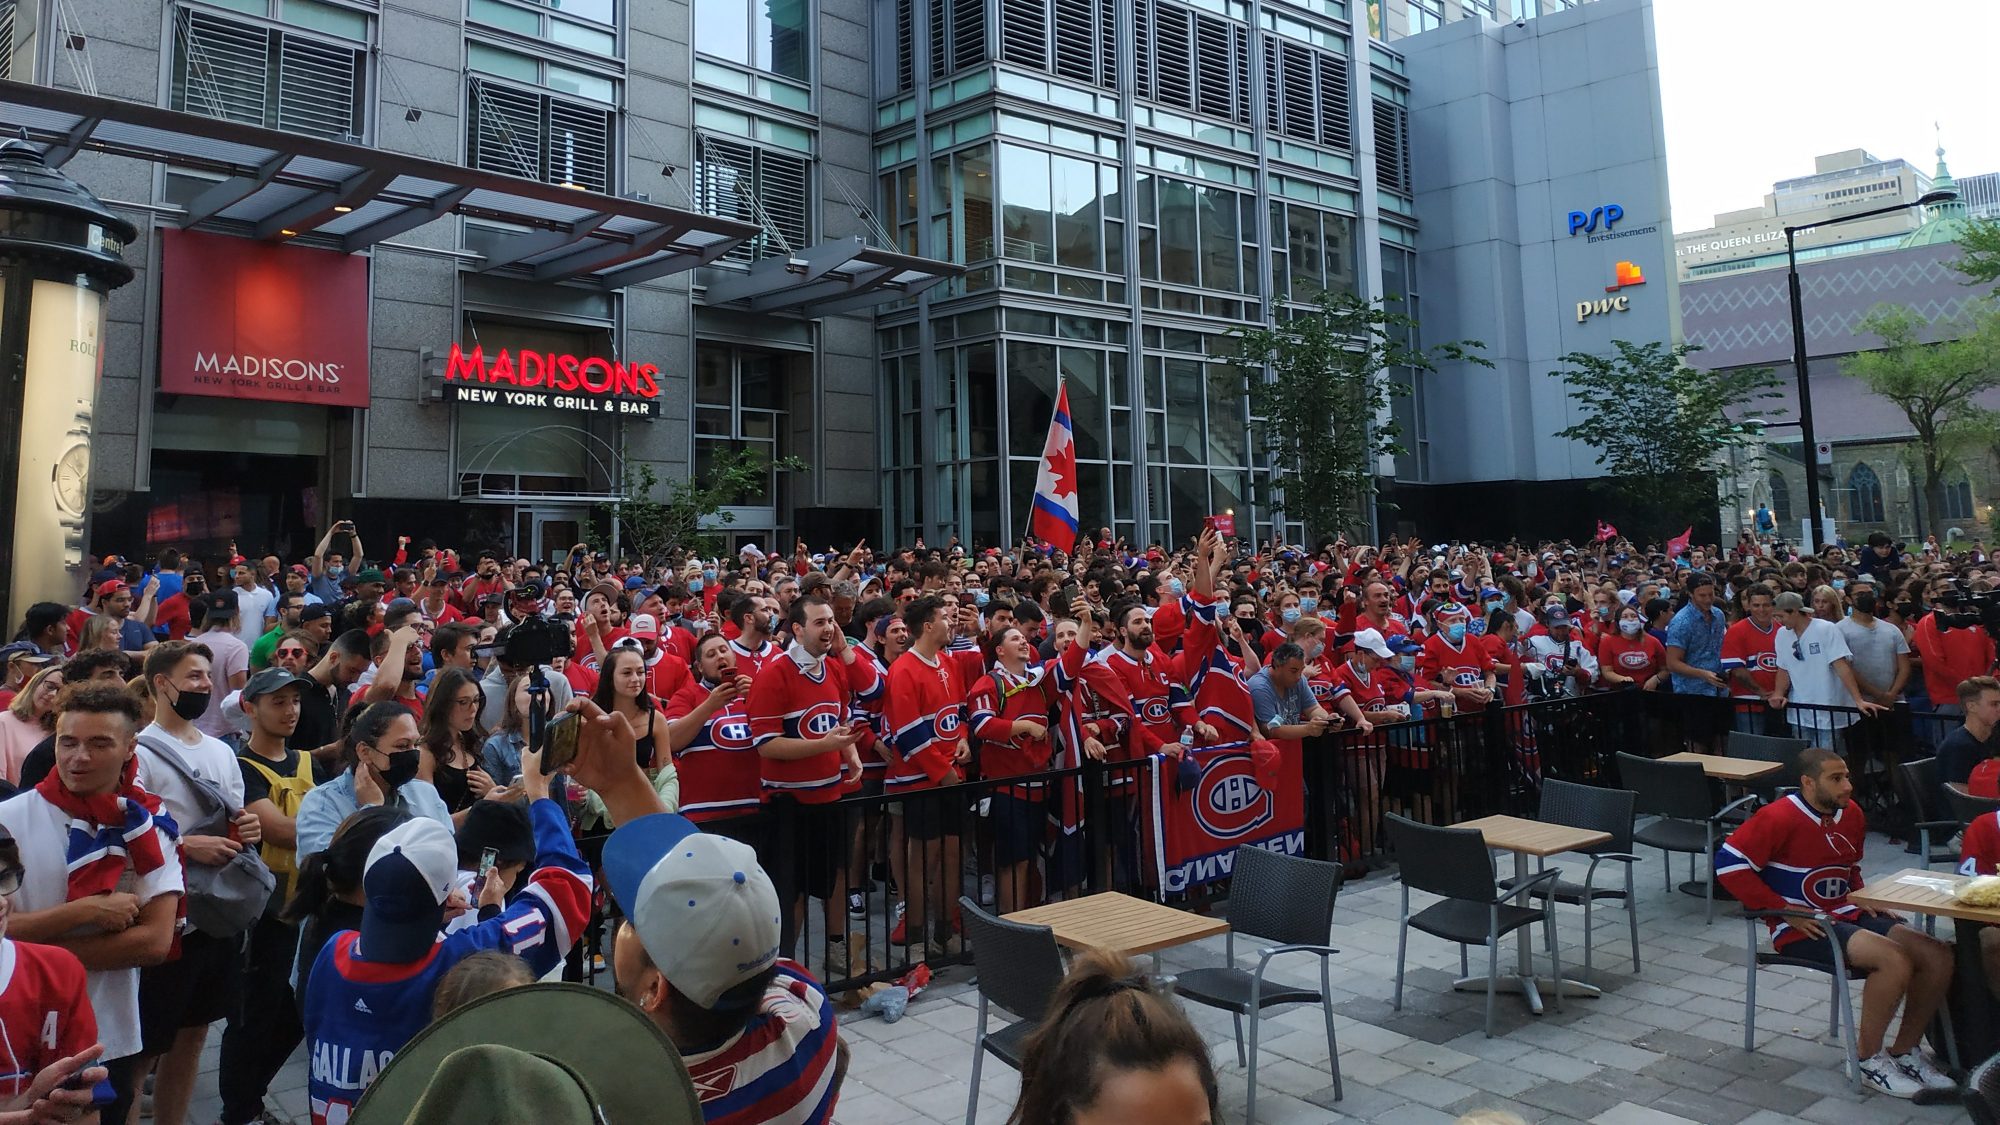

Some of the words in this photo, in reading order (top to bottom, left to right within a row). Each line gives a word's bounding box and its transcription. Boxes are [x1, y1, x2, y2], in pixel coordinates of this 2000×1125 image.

[1568, 204, 1624, 236] PSP
[1587, 225, 1657, 244] Investissements
[1686, 243, 1708, 254] THE
[1711, 236, 1751, 250] QUEEN
[1576, 295, 1631, 323] pwc
[194, 351, 342, 384] MADISONS
[445, 342, 660, 398] MADISONS
[194, 375, 222, 385] NEW
[230, 378, 261, 388] YORK
[266, 381, 300, 391] GRILL
[318, 385, 341, 393] BAR
[457, 388, 497, 403] NEW
[505, 392, 547, 407] YORK
[553, 396, 598, 411] GRILL
[604, 400, 614, 412] &
[620, 402, 649, 415] BAR
